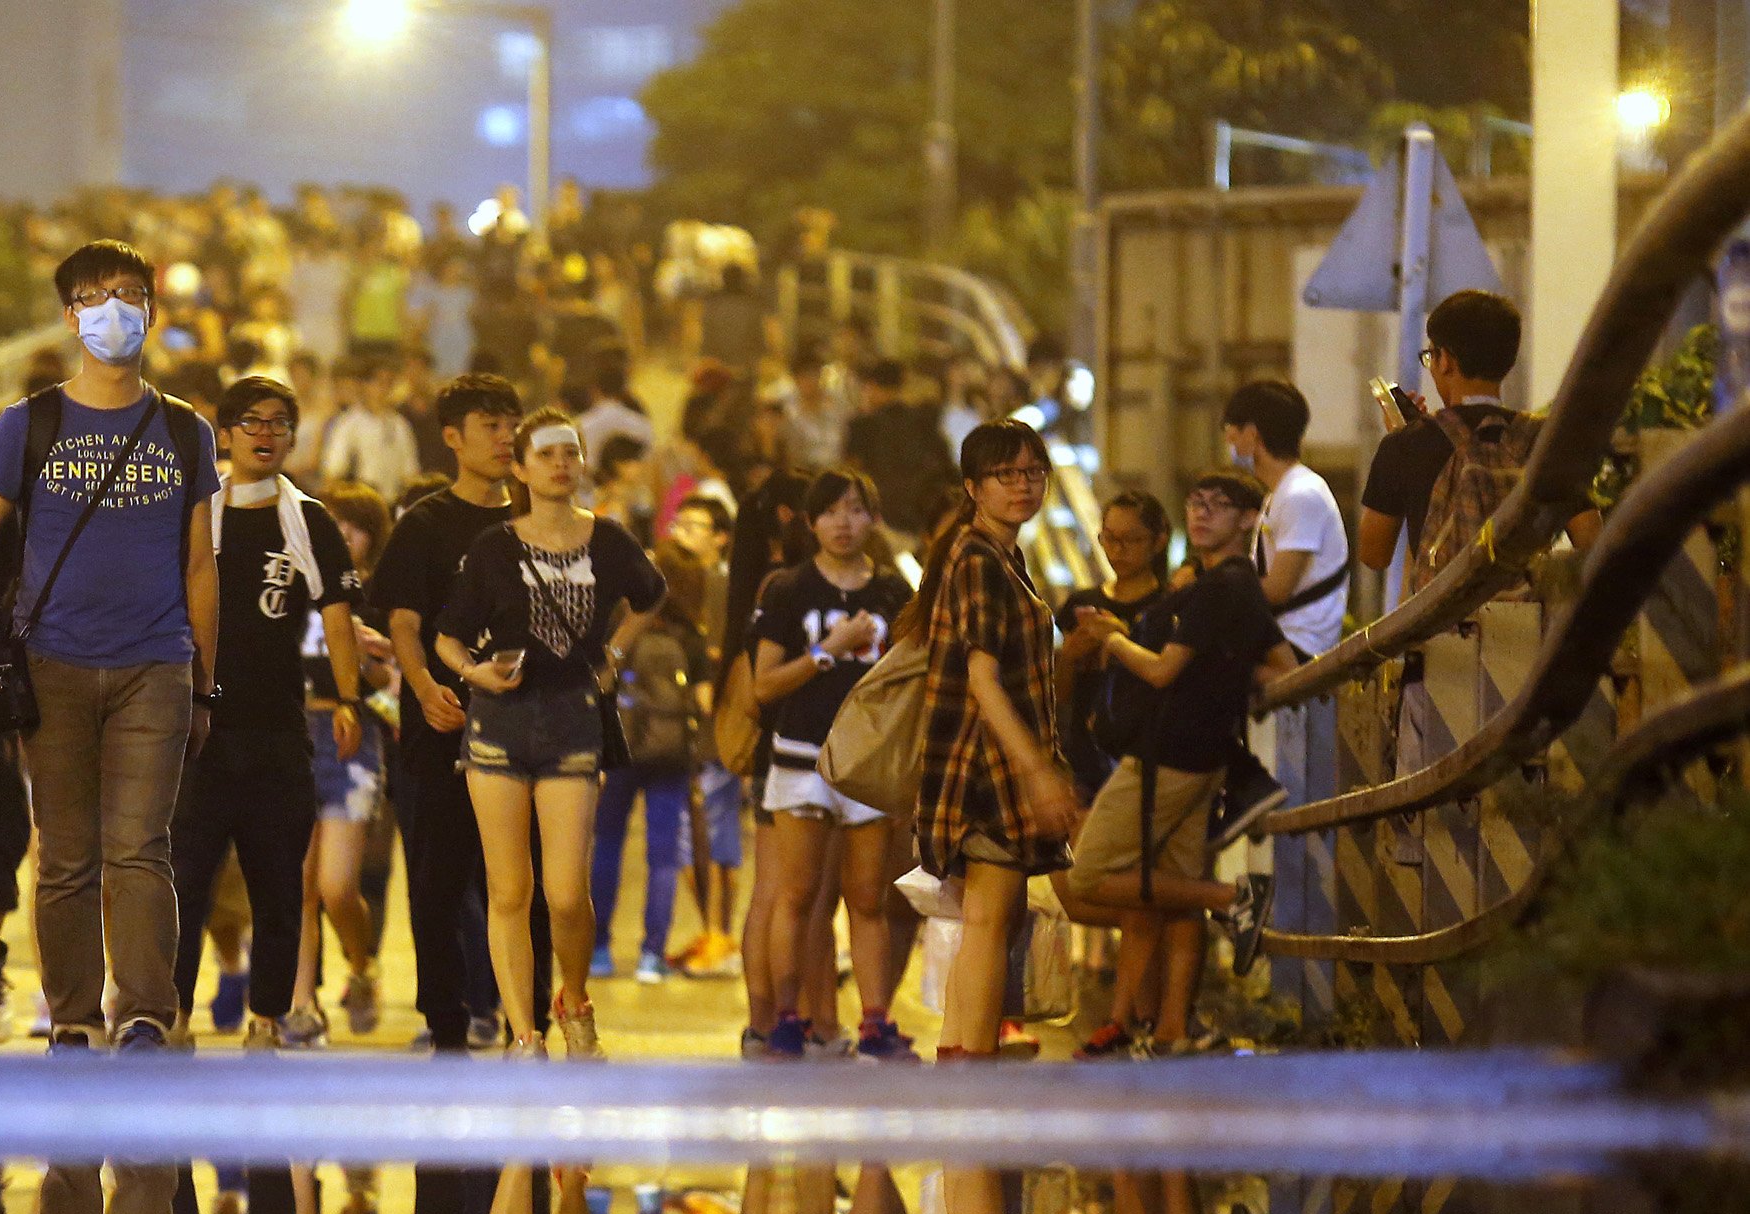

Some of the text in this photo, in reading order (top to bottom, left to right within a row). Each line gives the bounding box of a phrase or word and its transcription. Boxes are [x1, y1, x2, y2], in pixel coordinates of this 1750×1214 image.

[49, 434, 104, 457] ITCHEN
[146, 442, 175, 465] BAR
[77, 449, 115, 461] LOCALS
[46, 480, 67, 496] GET
[70, 490, 83, 502] IT
[129, 494, 150, 507] ITS
[153, 487, 173, 502] HOT
[114, 482, 137, 493] HERE
